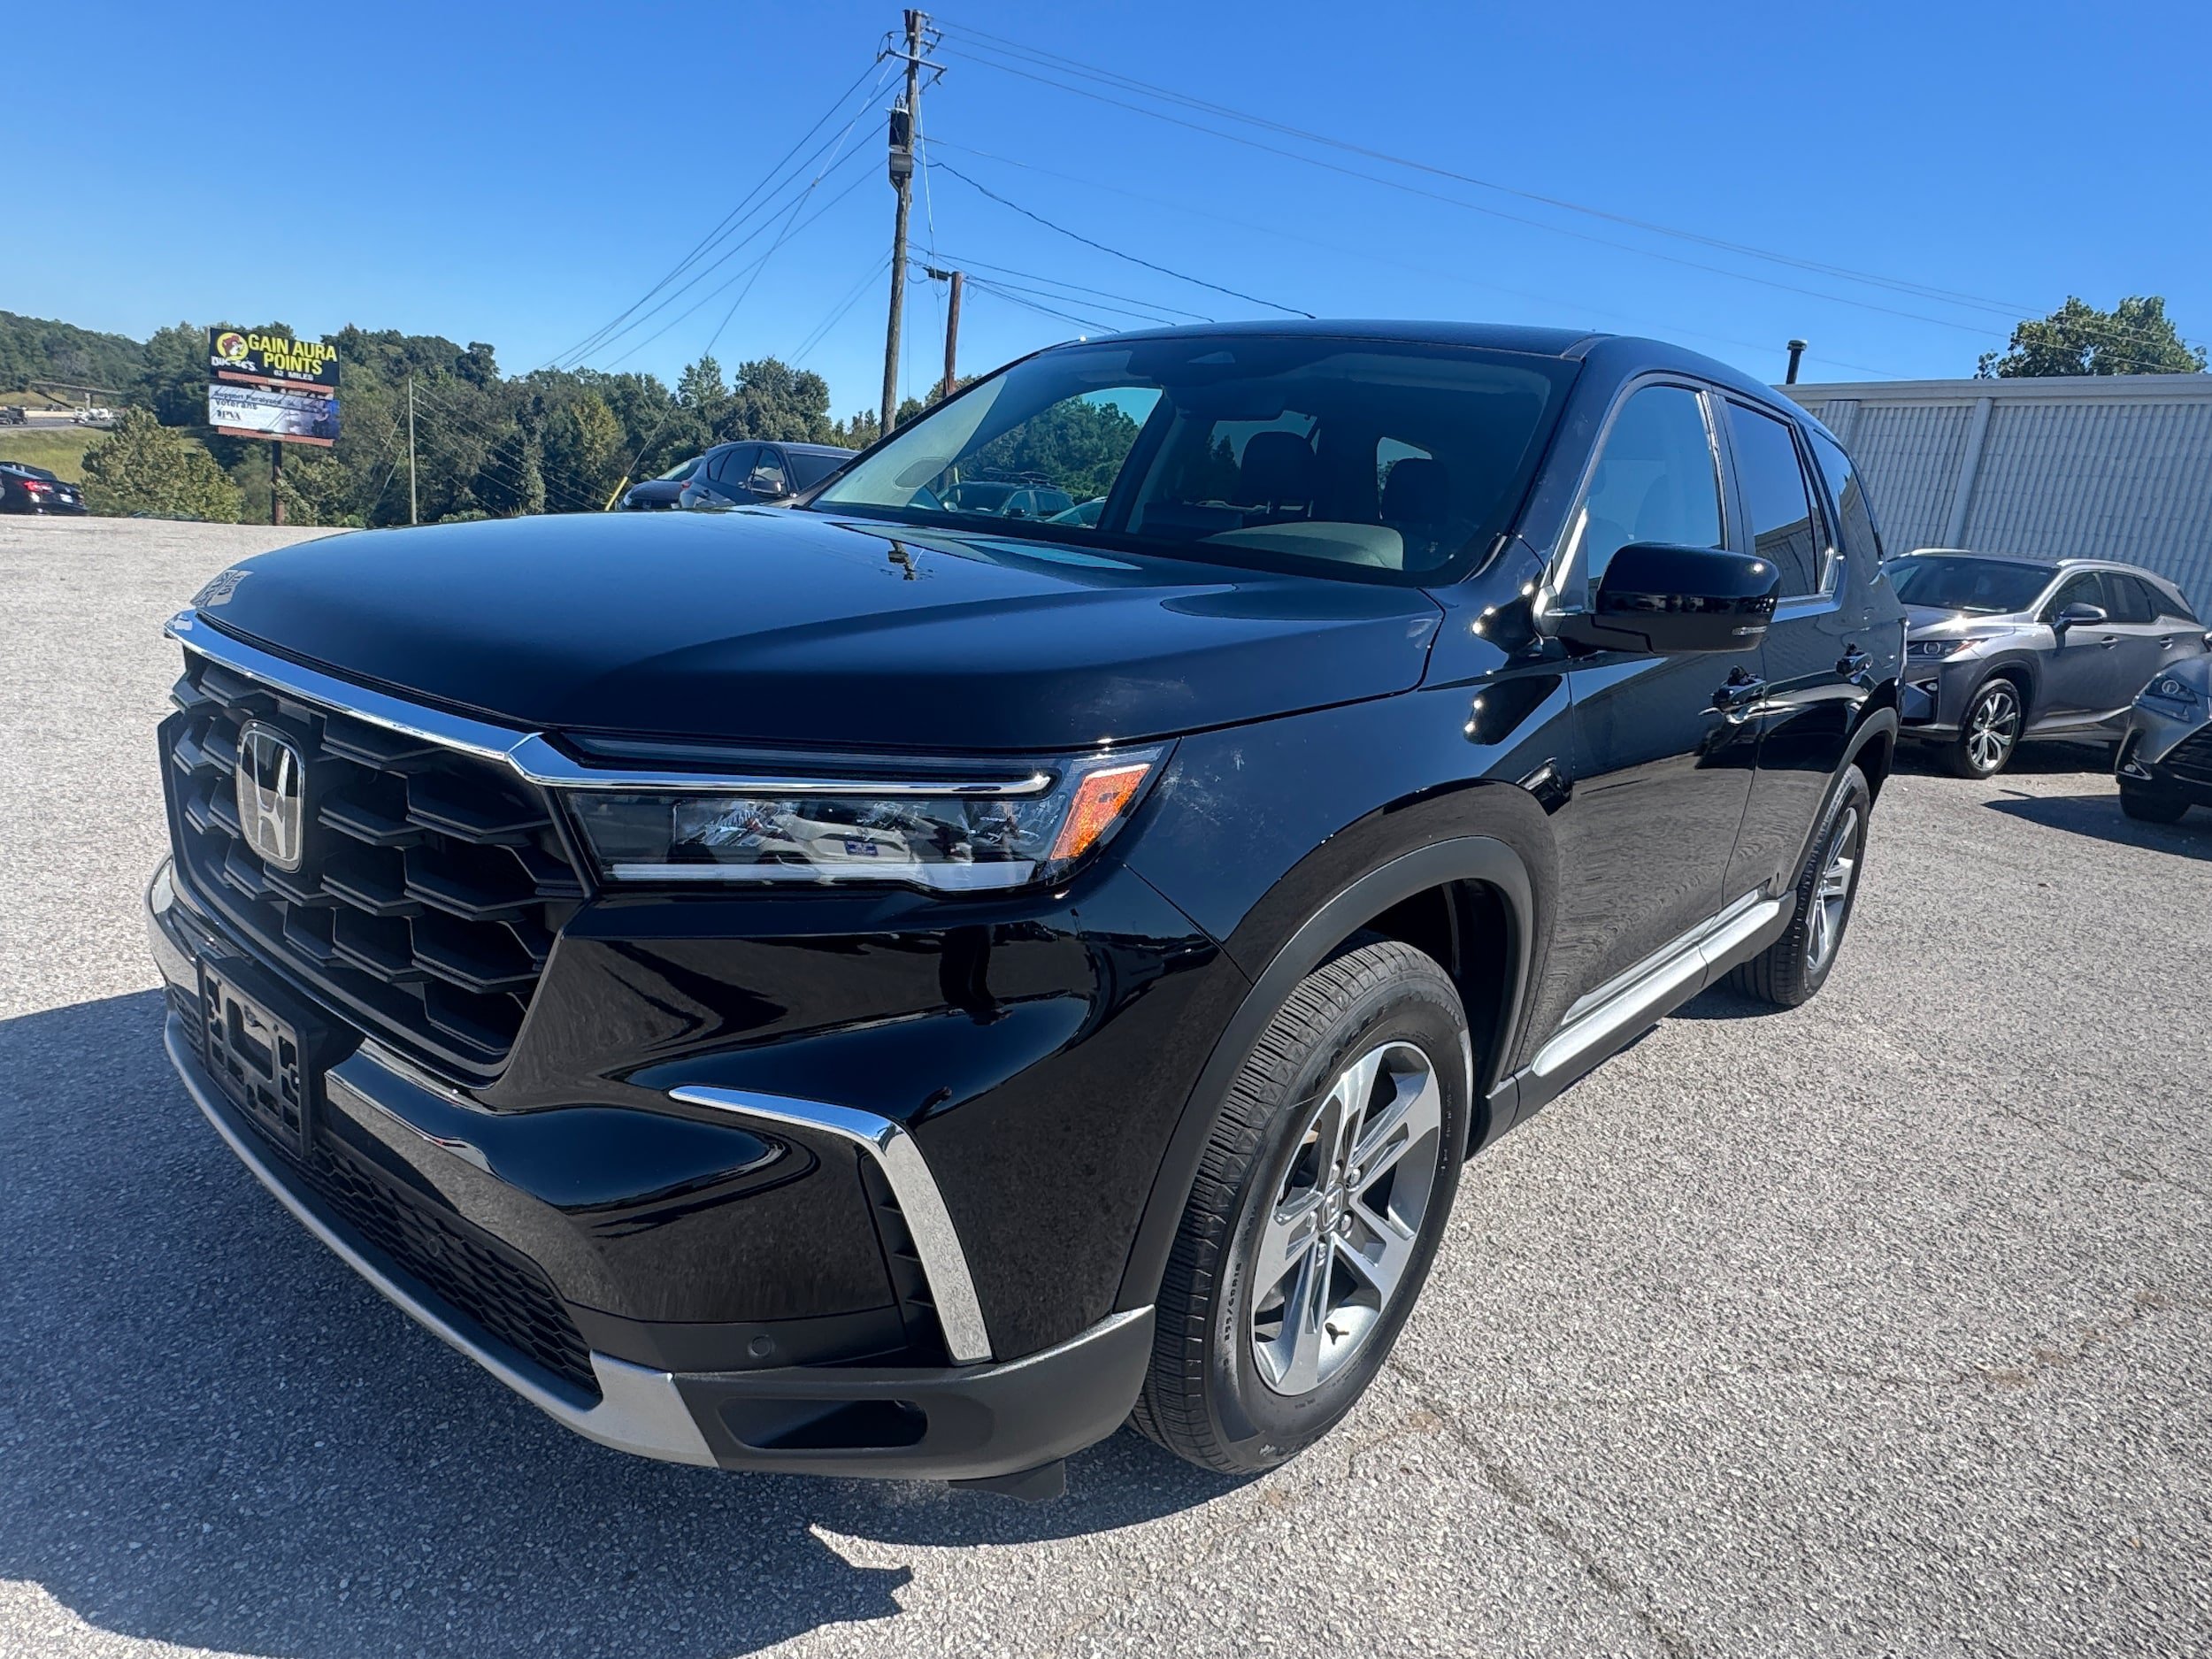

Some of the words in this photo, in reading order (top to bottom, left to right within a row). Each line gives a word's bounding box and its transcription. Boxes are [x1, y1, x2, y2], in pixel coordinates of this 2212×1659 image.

[249, 334, 288, 354] GAIN
[293, 341, 337, 362] AURA
[264, 352, 322, 375] POINTS
[288, 372, 314, 381] MILES
